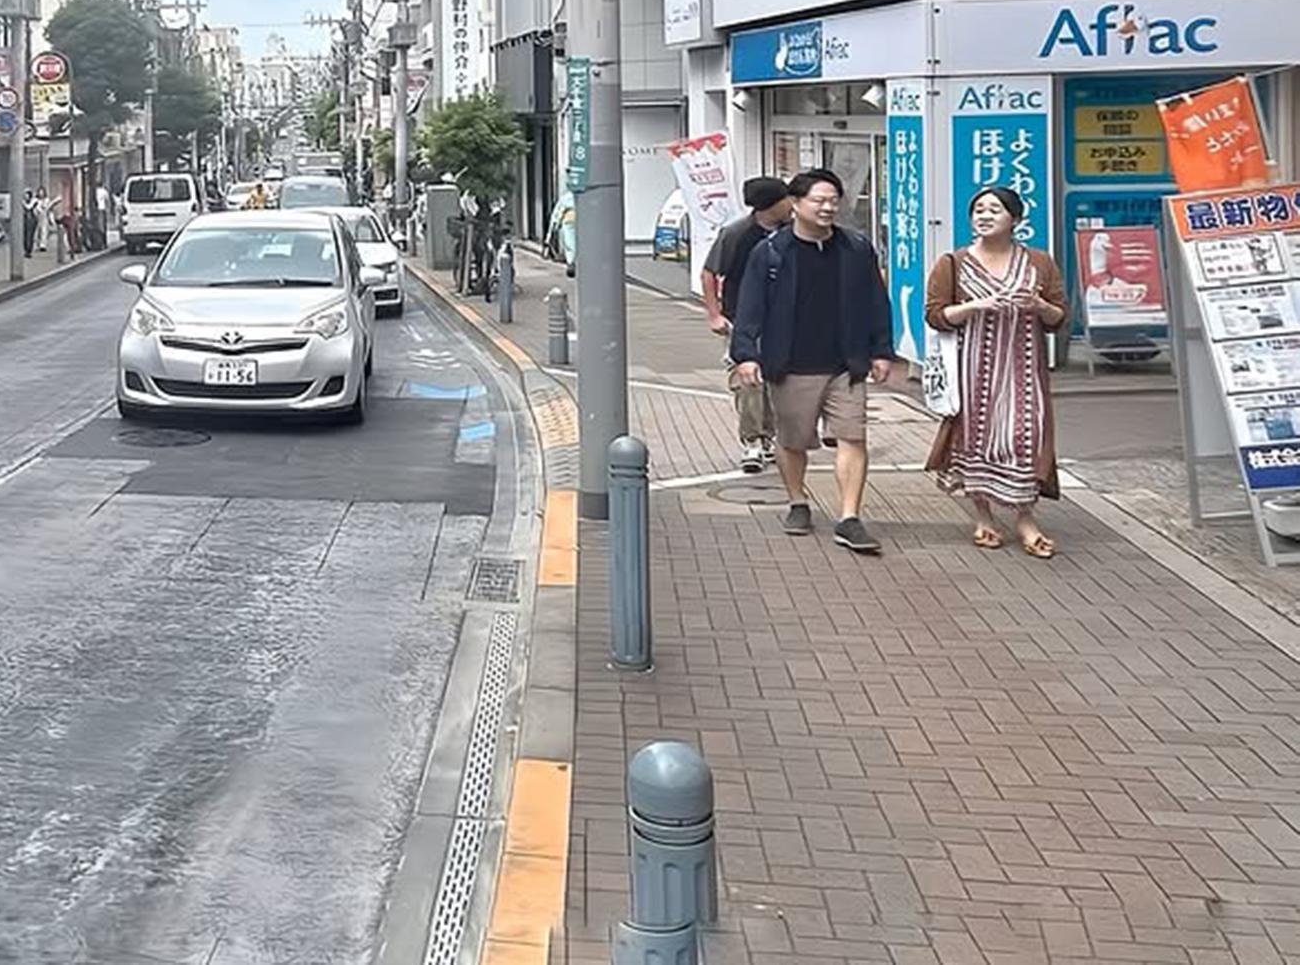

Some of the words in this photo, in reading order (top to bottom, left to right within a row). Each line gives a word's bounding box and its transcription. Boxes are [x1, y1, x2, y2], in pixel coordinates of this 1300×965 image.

[1038, 4, 1218, 57] Aflac
[958, 84, 1043, 110] Aflac
[973, 129, 1004, 188] ほけ
[1186, 192, 1300, 230] 最新物
